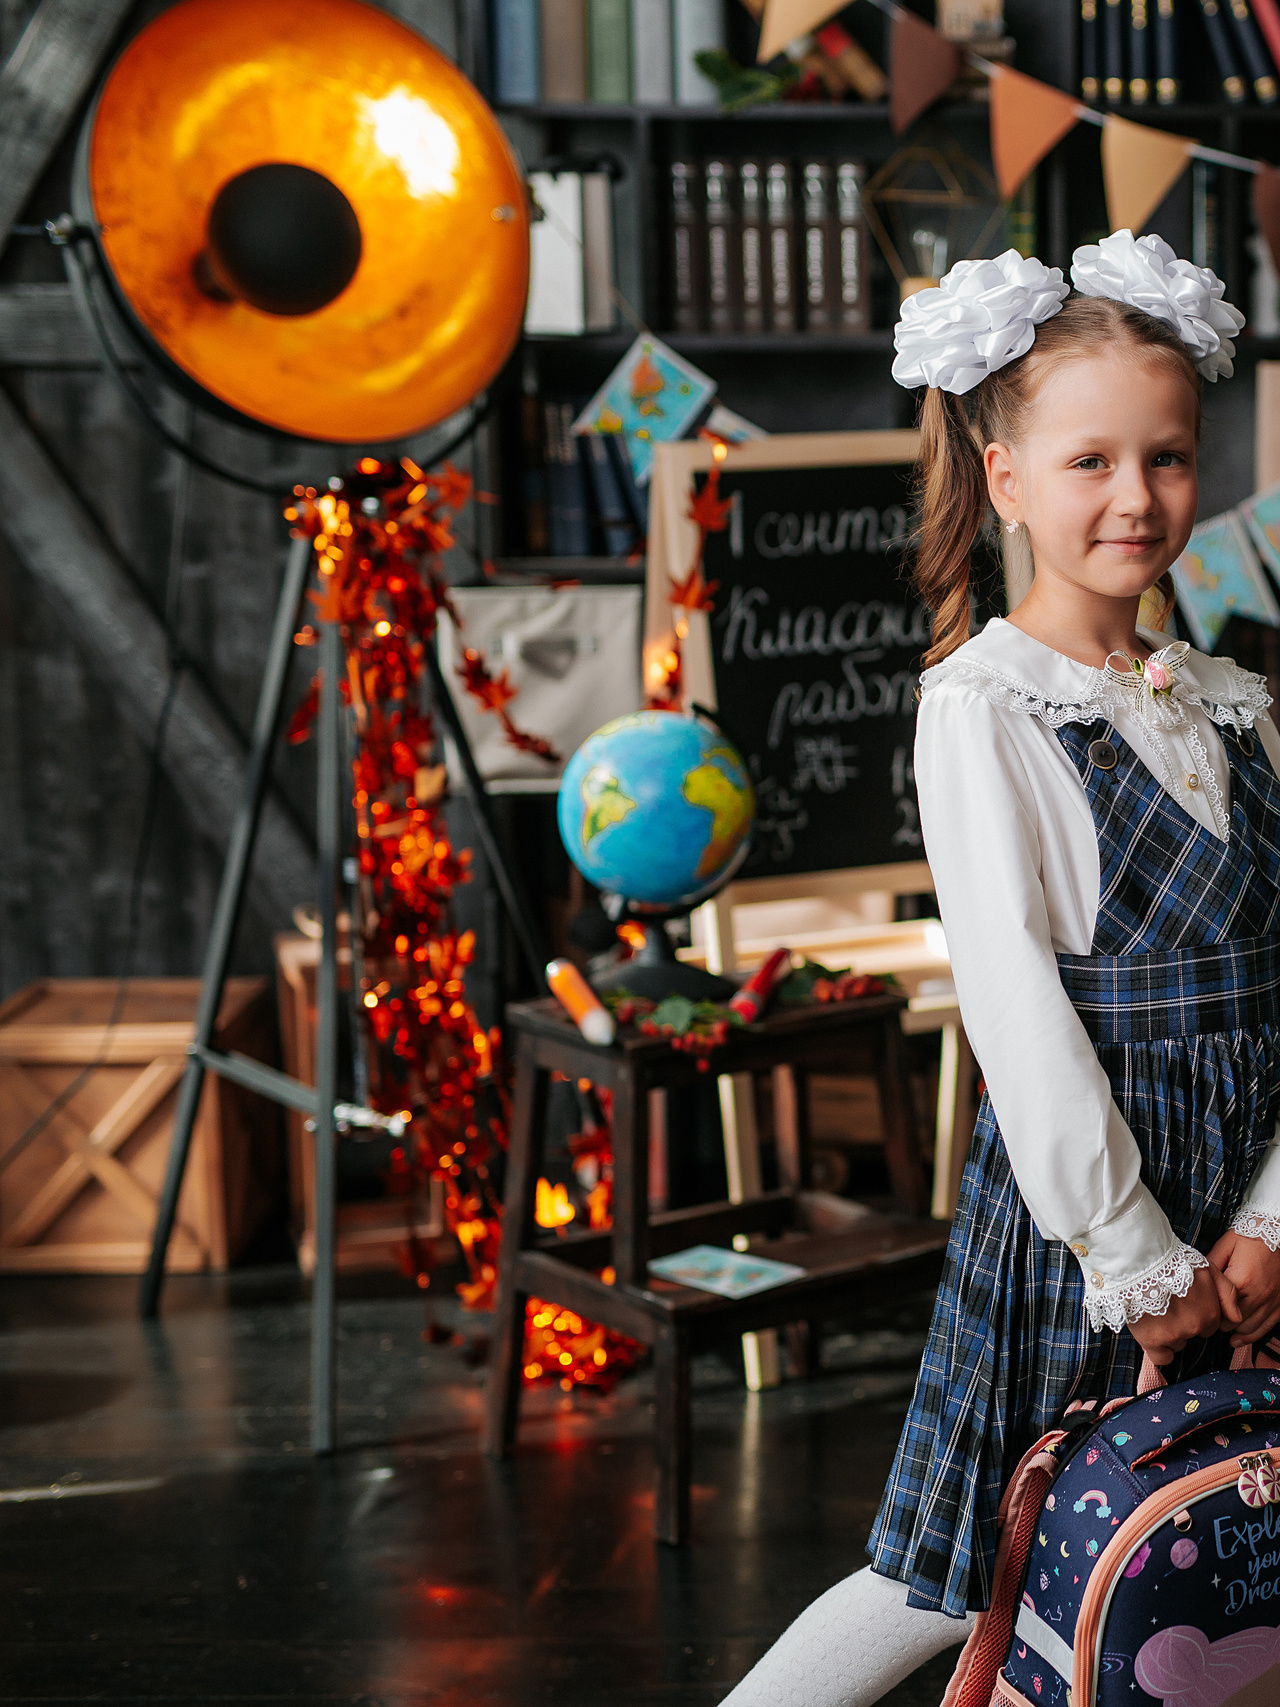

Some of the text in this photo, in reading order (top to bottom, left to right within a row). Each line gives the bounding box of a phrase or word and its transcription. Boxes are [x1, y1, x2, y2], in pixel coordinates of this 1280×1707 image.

[730, 489, 928, 560] 1 сентя
[715, 583, 938, 663] Классна
[767, 648, 921, 749] работ
